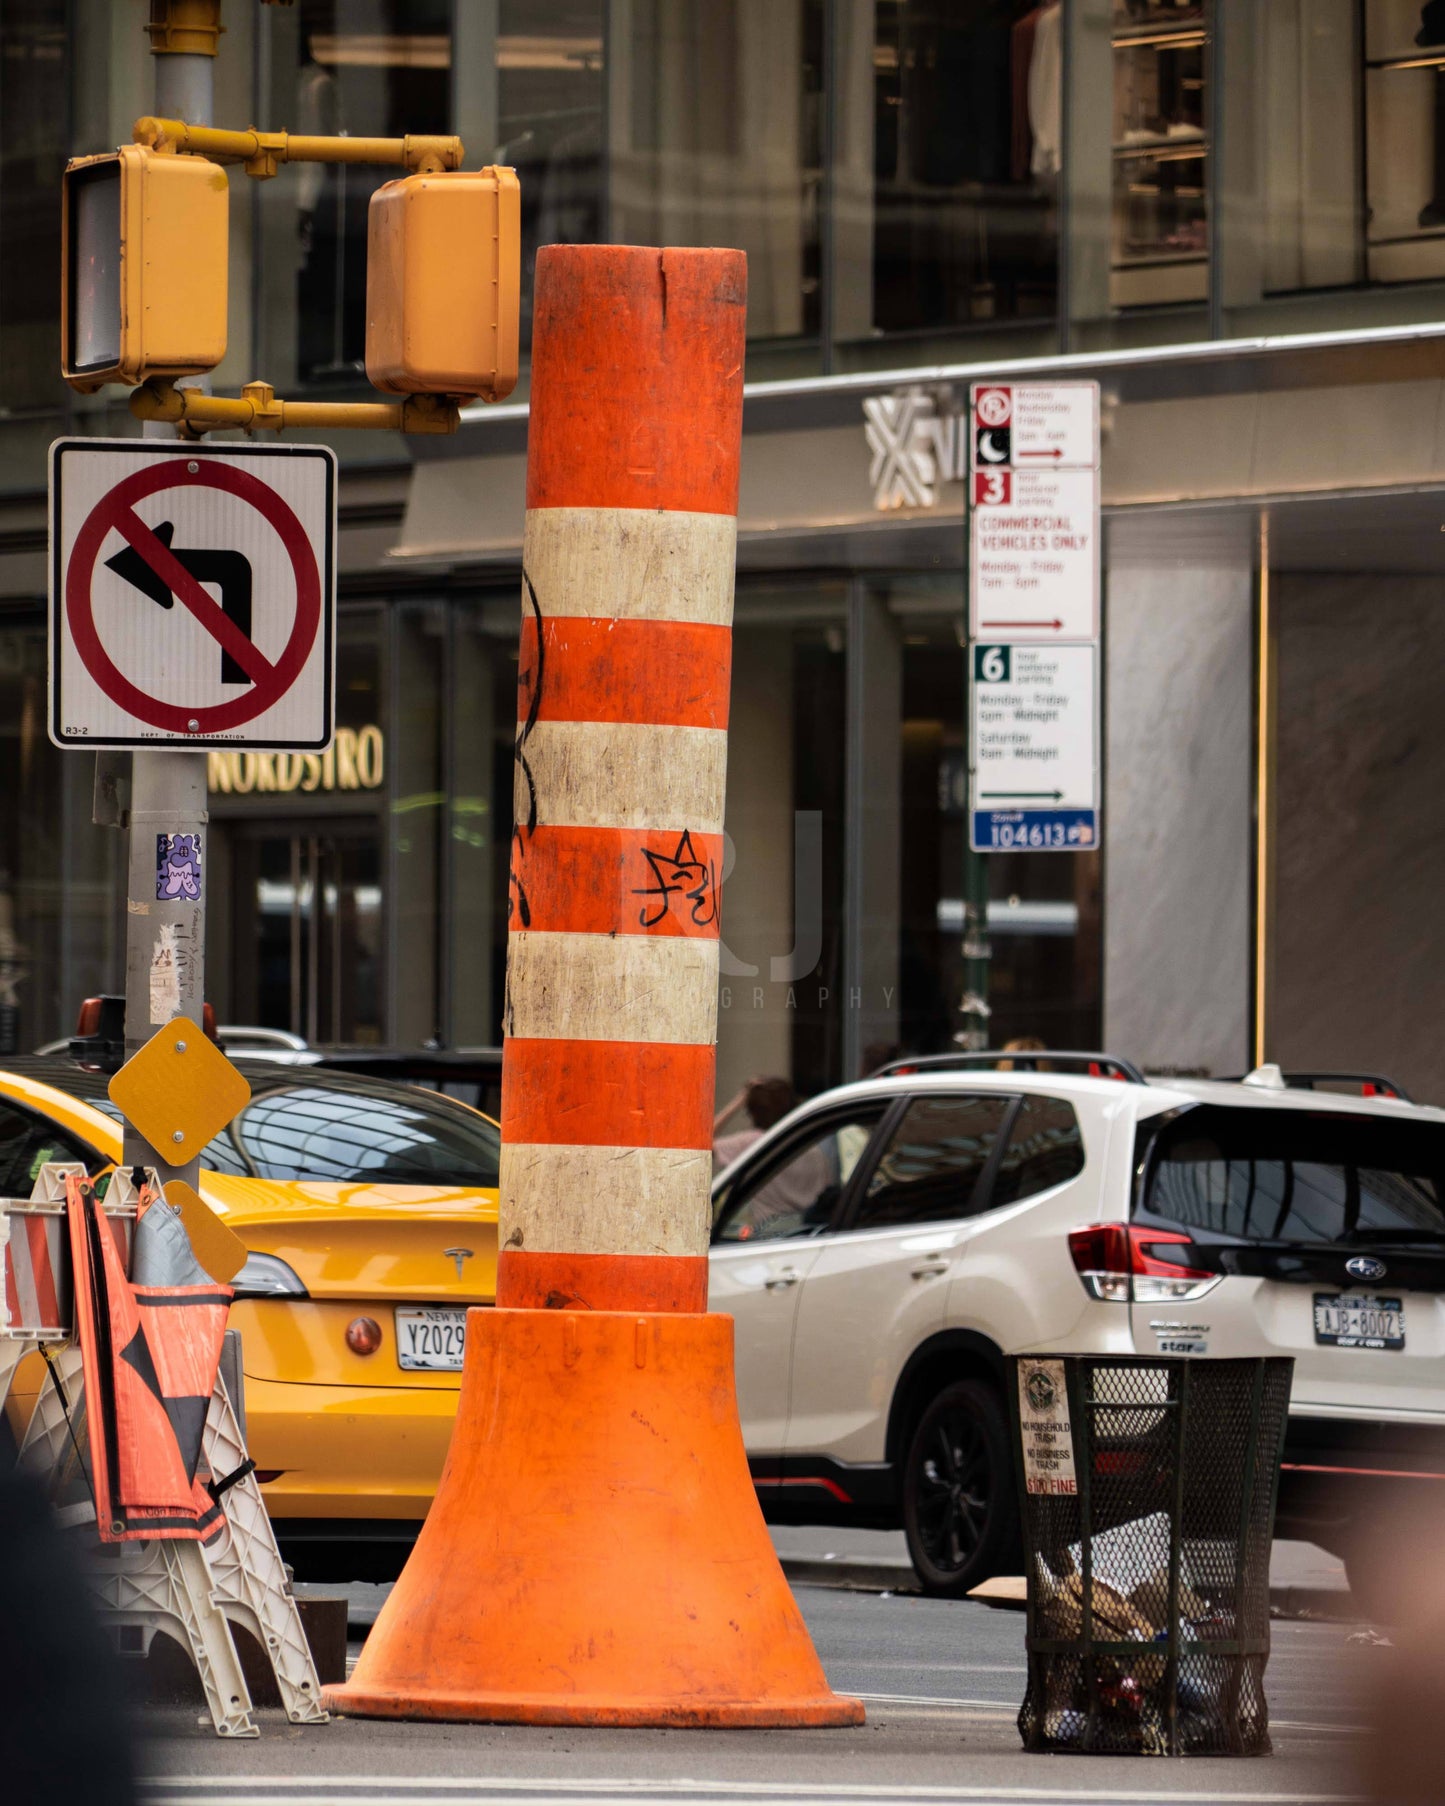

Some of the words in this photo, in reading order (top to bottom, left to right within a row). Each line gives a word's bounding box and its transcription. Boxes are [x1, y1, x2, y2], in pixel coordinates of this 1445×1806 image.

[982, 468, 1006, 505] 3
[981, 517, 1072, 531] COMMERCIAL
[981, 535, 1047, 551] VEHICLES
[1052, 535, 1089, 551] ONLY
[981, 561, 1021, 574] Monday
[1031, 561, 1064, 574] Friday
[982, 647, 1005, 682] 6
[980, 694, 1024, 708] Monday
[1033, 694, 1069, 708] Friday
[1014, 709, 1059, 724] Midnight
[66, 727, 89, 736] R3-2
[980, 732, 1032, 746] Saturday
[1014, 747, 1059, 762] Midnight
[990, 822, 1065, 847] 104613
[426, 1312, 450, 1322] NEW
[408, 1324, 466, 1356] Y2029
[1022, 1421, 1029, 1431] NO
[1030, 1422, 1070, 1433] HOUSEHOLD
[1034, 1433, 1057, 1443] TRASH
[1027, 1448, 1035, 1459] NO
[1036, 1449, 1070, 1460] BUSINESS
[1035, 1460, 1059, 1470] TRASH
[1050, 1479, 1077, 1494] FINE
